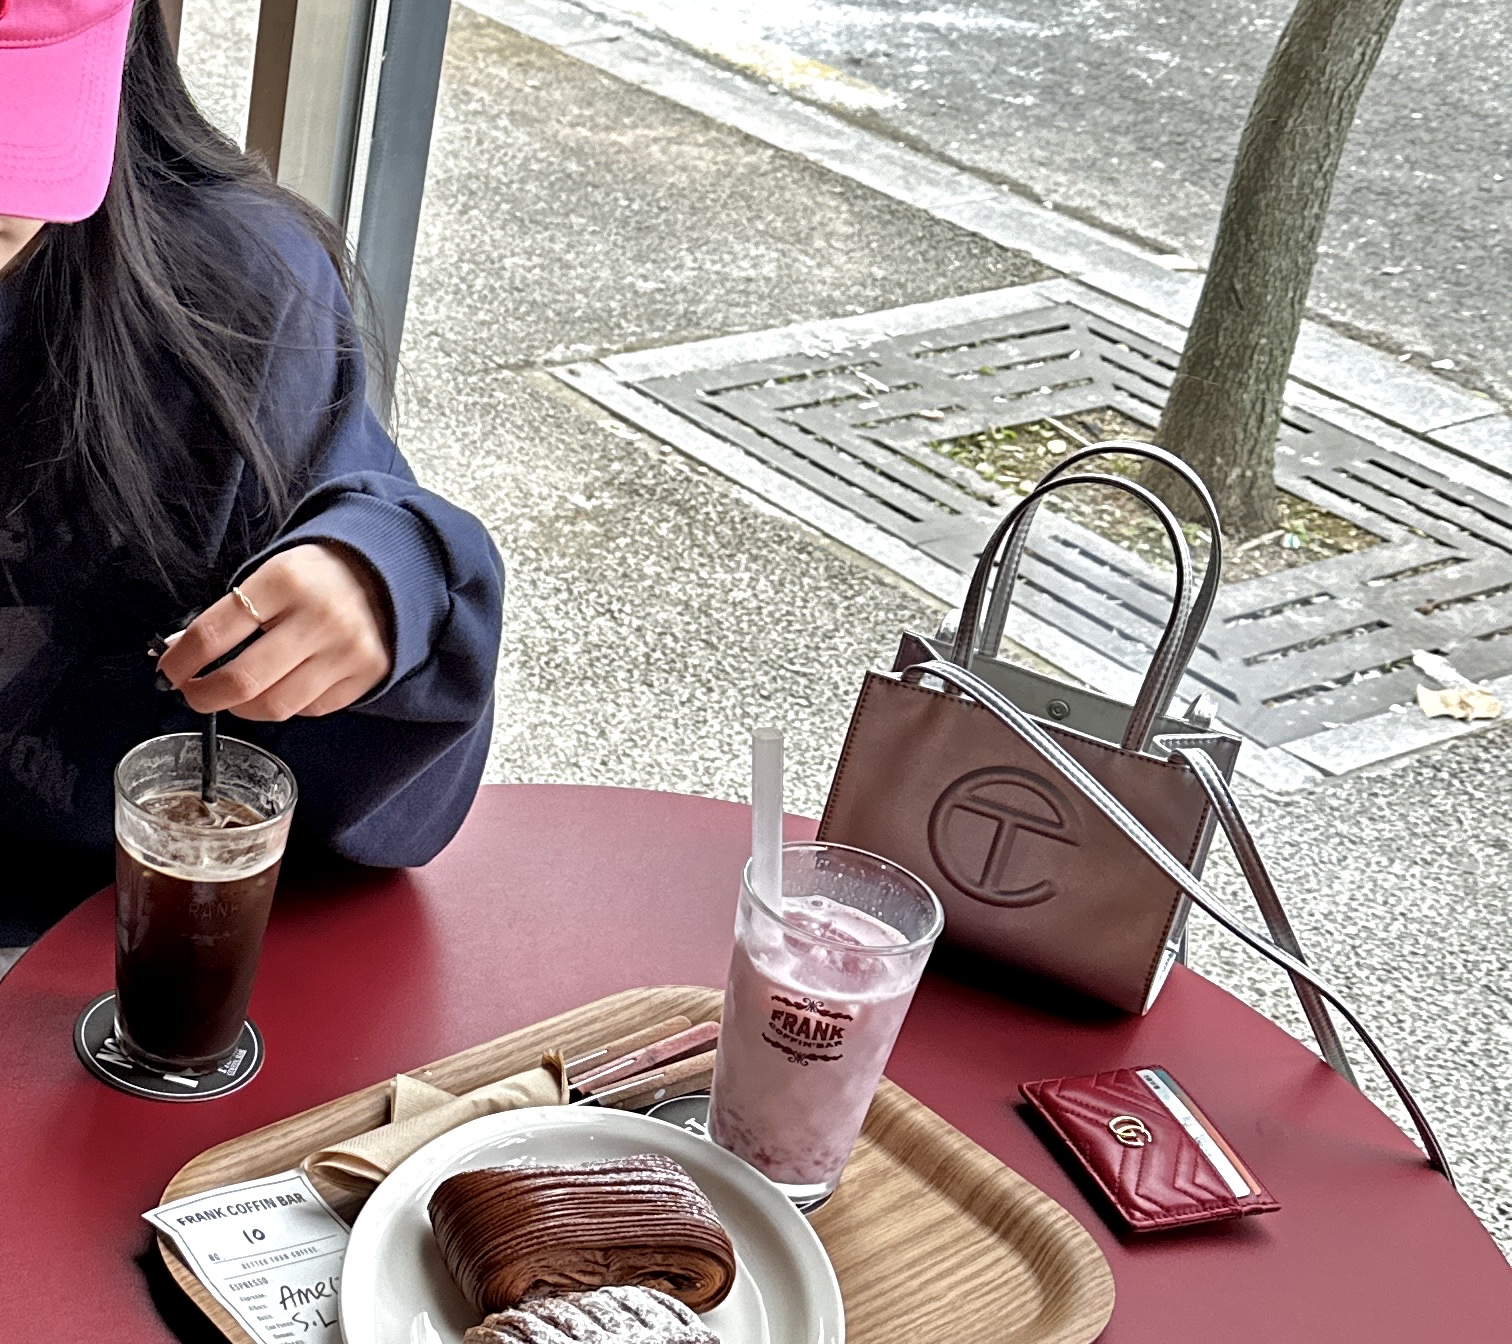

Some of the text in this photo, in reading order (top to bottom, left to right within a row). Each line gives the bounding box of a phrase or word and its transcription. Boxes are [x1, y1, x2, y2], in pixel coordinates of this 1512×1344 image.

[770, 1008, 846, 1042] FRANK
[176, 1192, 307, 1227] FRANK COFFIN BAR
[242, 1228, 266, 1245] 10
[228, 1276, 269, 1292] ESPRESSO
